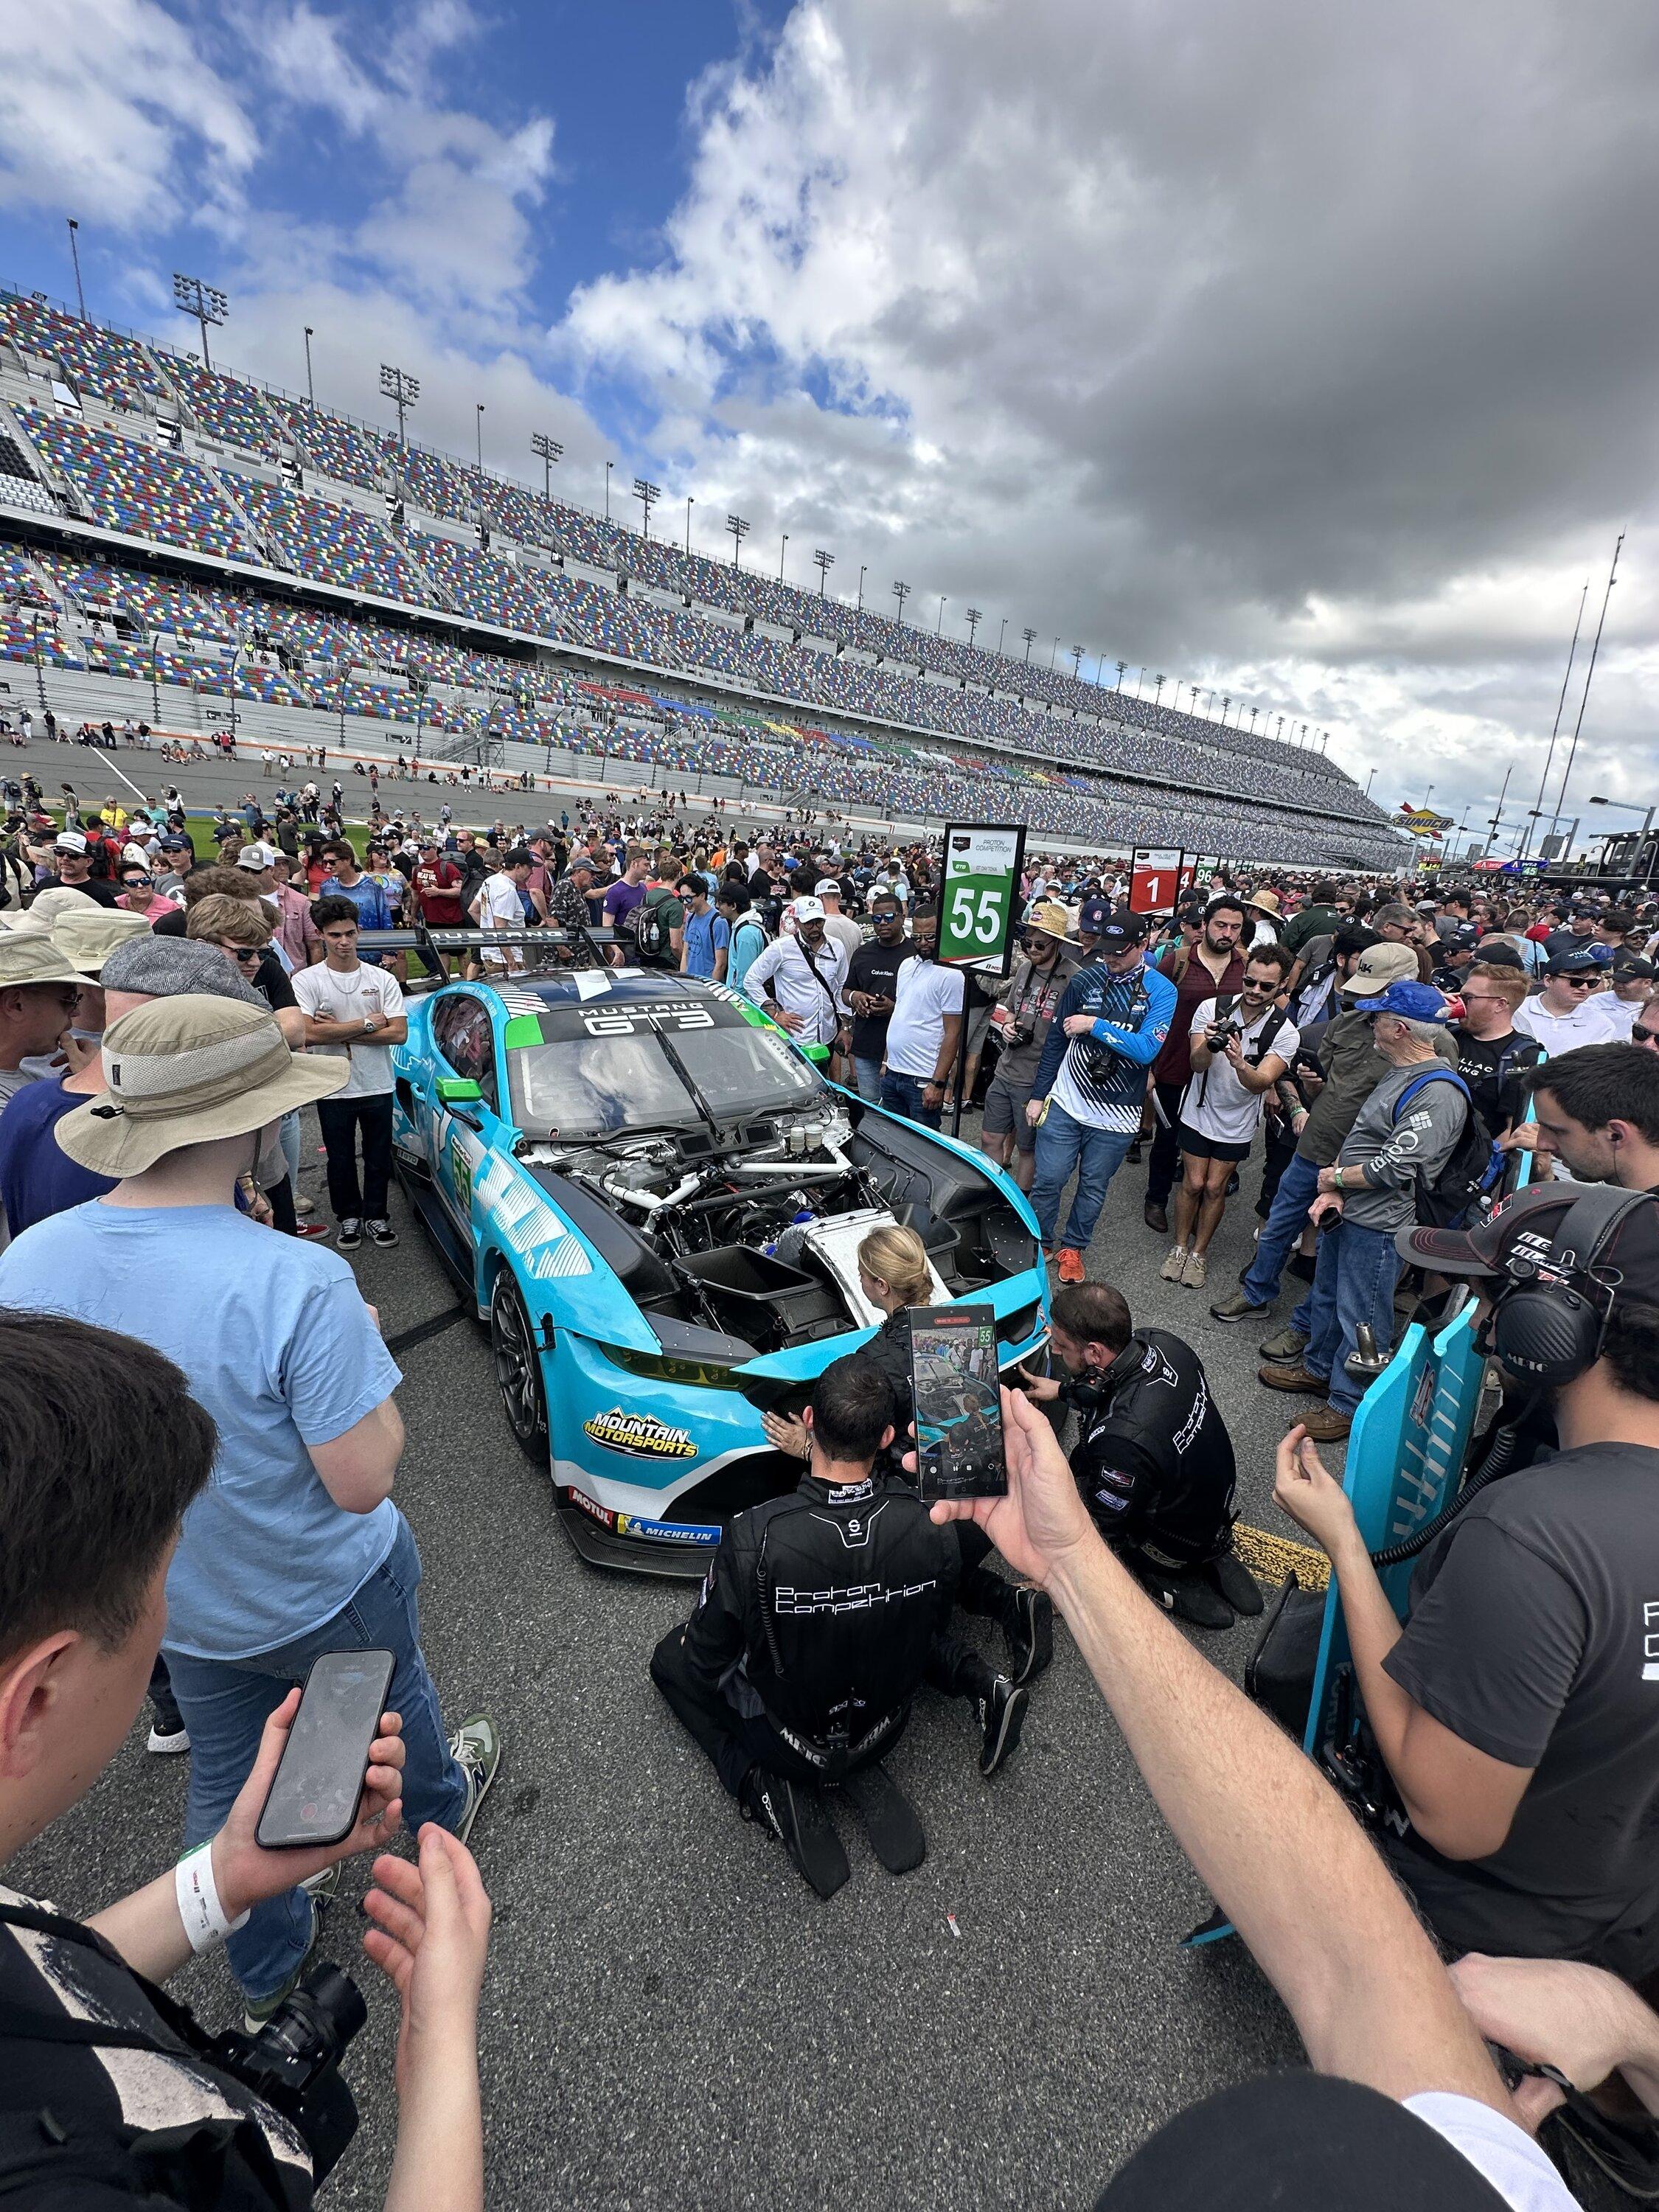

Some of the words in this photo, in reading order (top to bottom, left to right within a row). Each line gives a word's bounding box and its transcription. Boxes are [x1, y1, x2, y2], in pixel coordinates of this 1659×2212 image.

[1398, 816, 1452, 829] SUNOCO
[975, 845, 1012, 853] COMPETITION
[1197, 869, 1212, 883] 96
[1147, 877, 1160, 902] 1
[950, 887, 1002, 944] 55
[430, 931, 563, 939] MUSTANG
[577, 1002, 704, 1017] MUSTANG
[584, 1009, 715, 1036] GT3
[1458, 1065, 1479, 1077] ING
[1460, 1057, 1493, 1073] LLAC
[980, 1330, 990, 1343] 55
[594, 1413, 690, 1443] MOUNTAIN
[585, 1422, 698, 1457] MOTORSPORTS
[571, 1492, 611, 1525] MOTUL
[645, 1527, 712, 1541] MICHELIN
[776, 1583, 880, 1601] Proton
[776, 1580, 936, 1615] Competition
